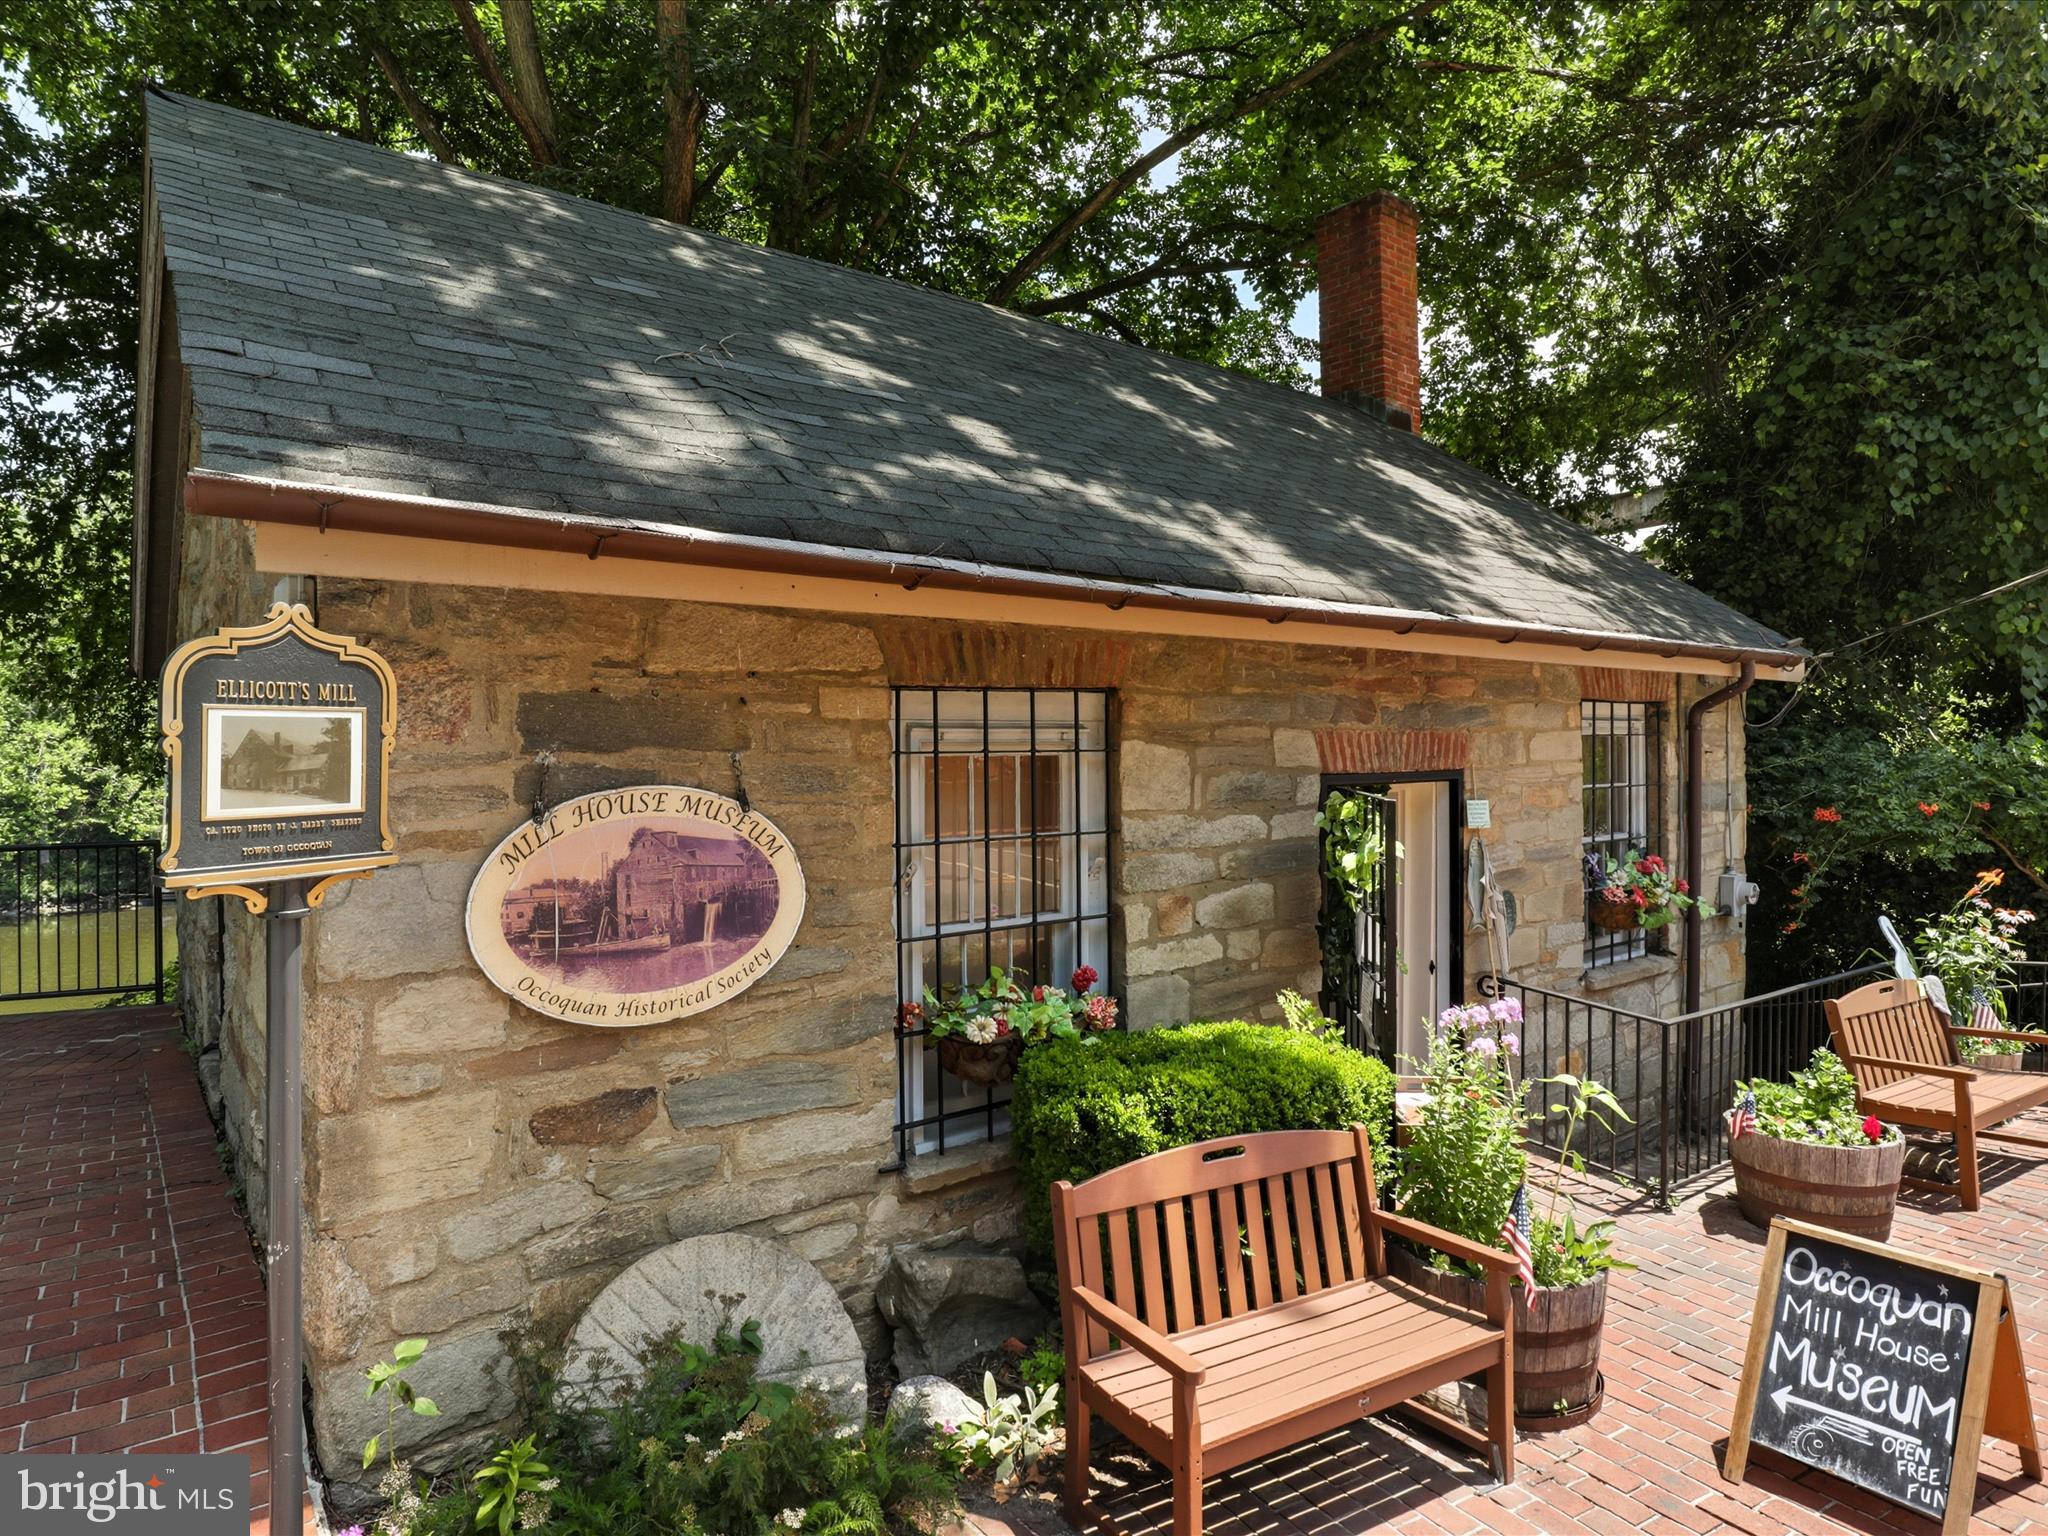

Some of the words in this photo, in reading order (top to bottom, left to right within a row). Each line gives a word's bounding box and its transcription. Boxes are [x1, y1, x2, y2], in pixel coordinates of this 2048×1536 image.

[216, 679, 310, 701] ELLICOTT'S
[318, 682, 357, 702] MILL
[242, 845, 271, 856] TOWN
[273, 844, 286, 853] OF
[287, 840, 333, 852] OCCOQUAN
[500, 813, 565, 876] MILL
[572, 791, 670, 828] HOUSE
[675, 793, 786, 859] MUSEUM
[517, 976, 608, 1017] Occoquan
[613, 980, 713, 1018] Historical
[715, 947, 773, 995] Society
[1782, 1294, 1842, 1338] Mill
[1854, 1317, 1950, 1373] House
[1881, 1436, 1931, 1466] OPEN
